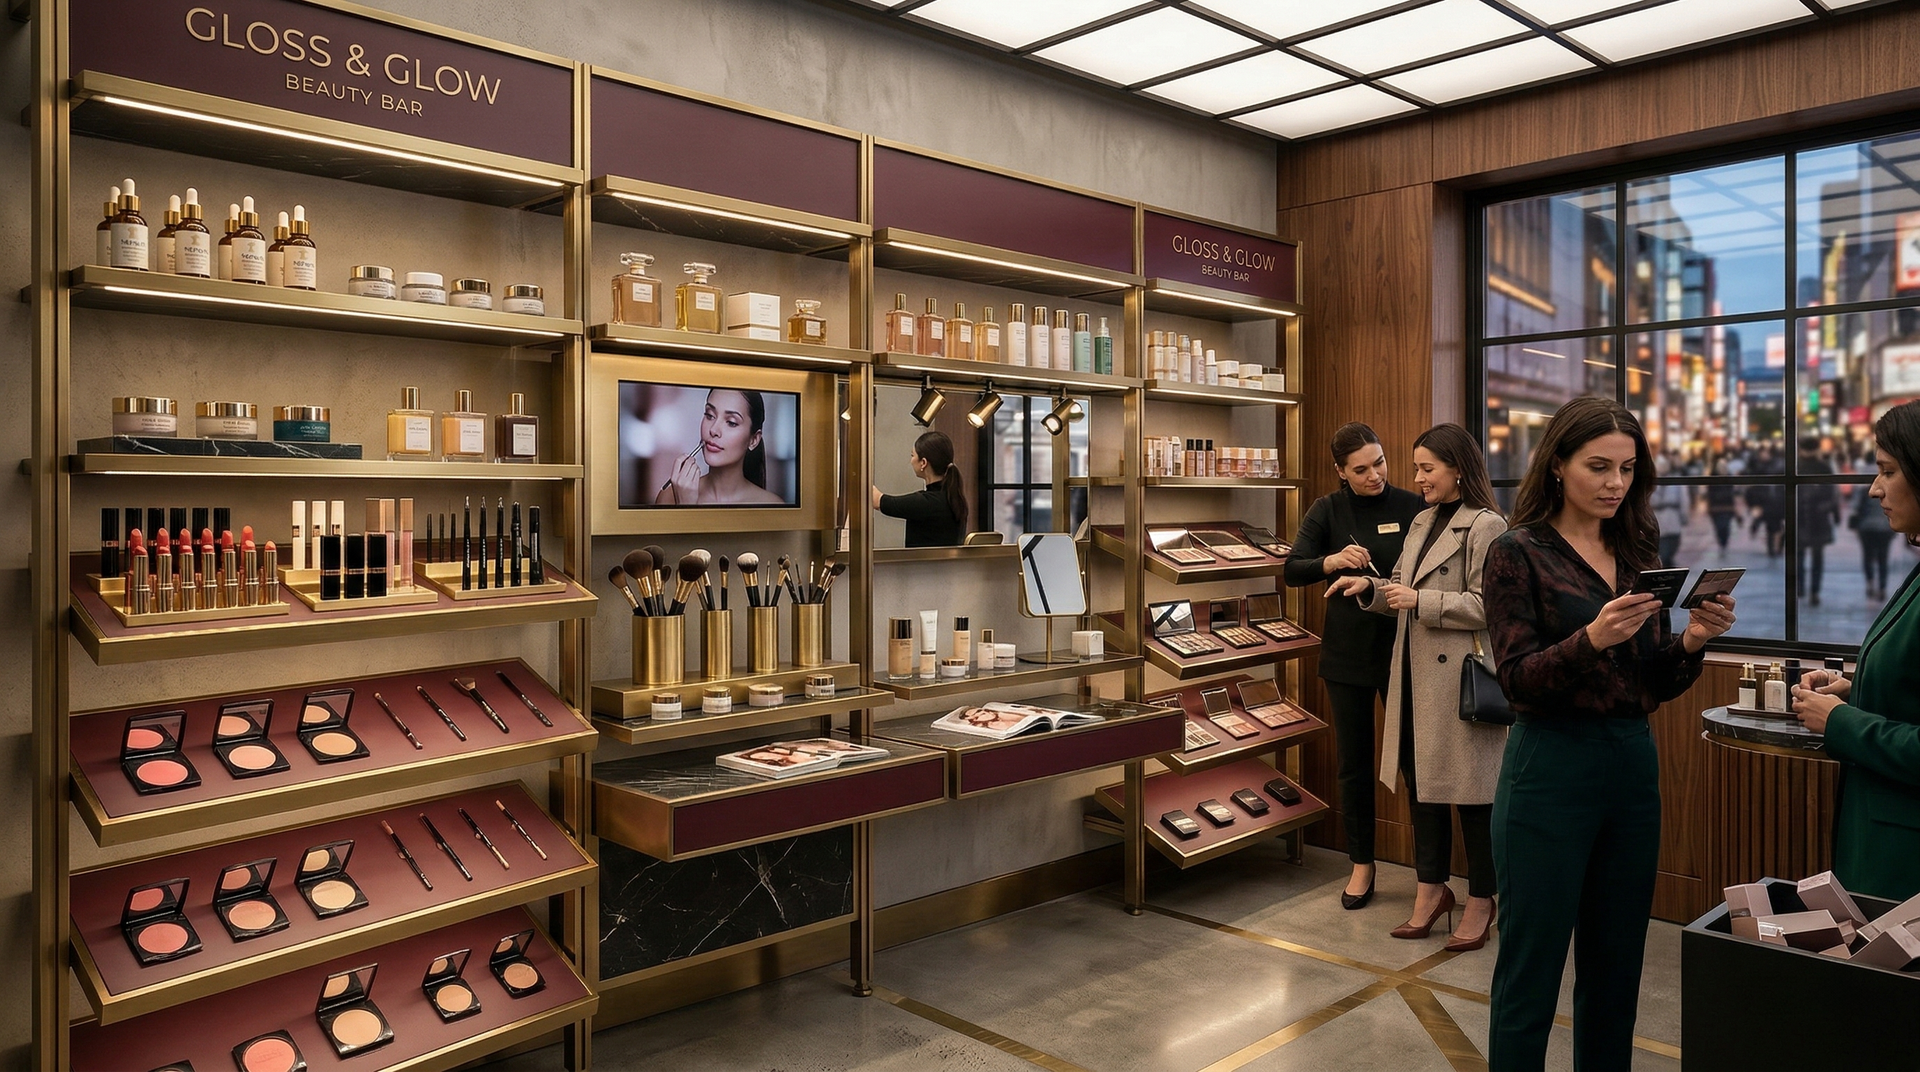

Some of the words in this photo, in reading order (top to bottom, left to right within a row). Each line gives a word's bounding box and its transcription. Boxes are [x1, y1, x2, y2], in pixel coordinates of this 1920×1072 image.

[185, 7, 332, 67] GLOSS
[345, 43, 371, 77] &
[384, 53, 502, 105] GLOW
[286, 73, 373, 105] BEAUTY
[381, 94, 423, 117] BAR
[1172, 235, 1219, 261] GLOSS
[1222, 245, 1232, 263] &
[1235, 248, 1276, 272] GLOW
[1201, 264, 1232, 279] BEAUTY
[1233, 271, 1250, 283] BAR
